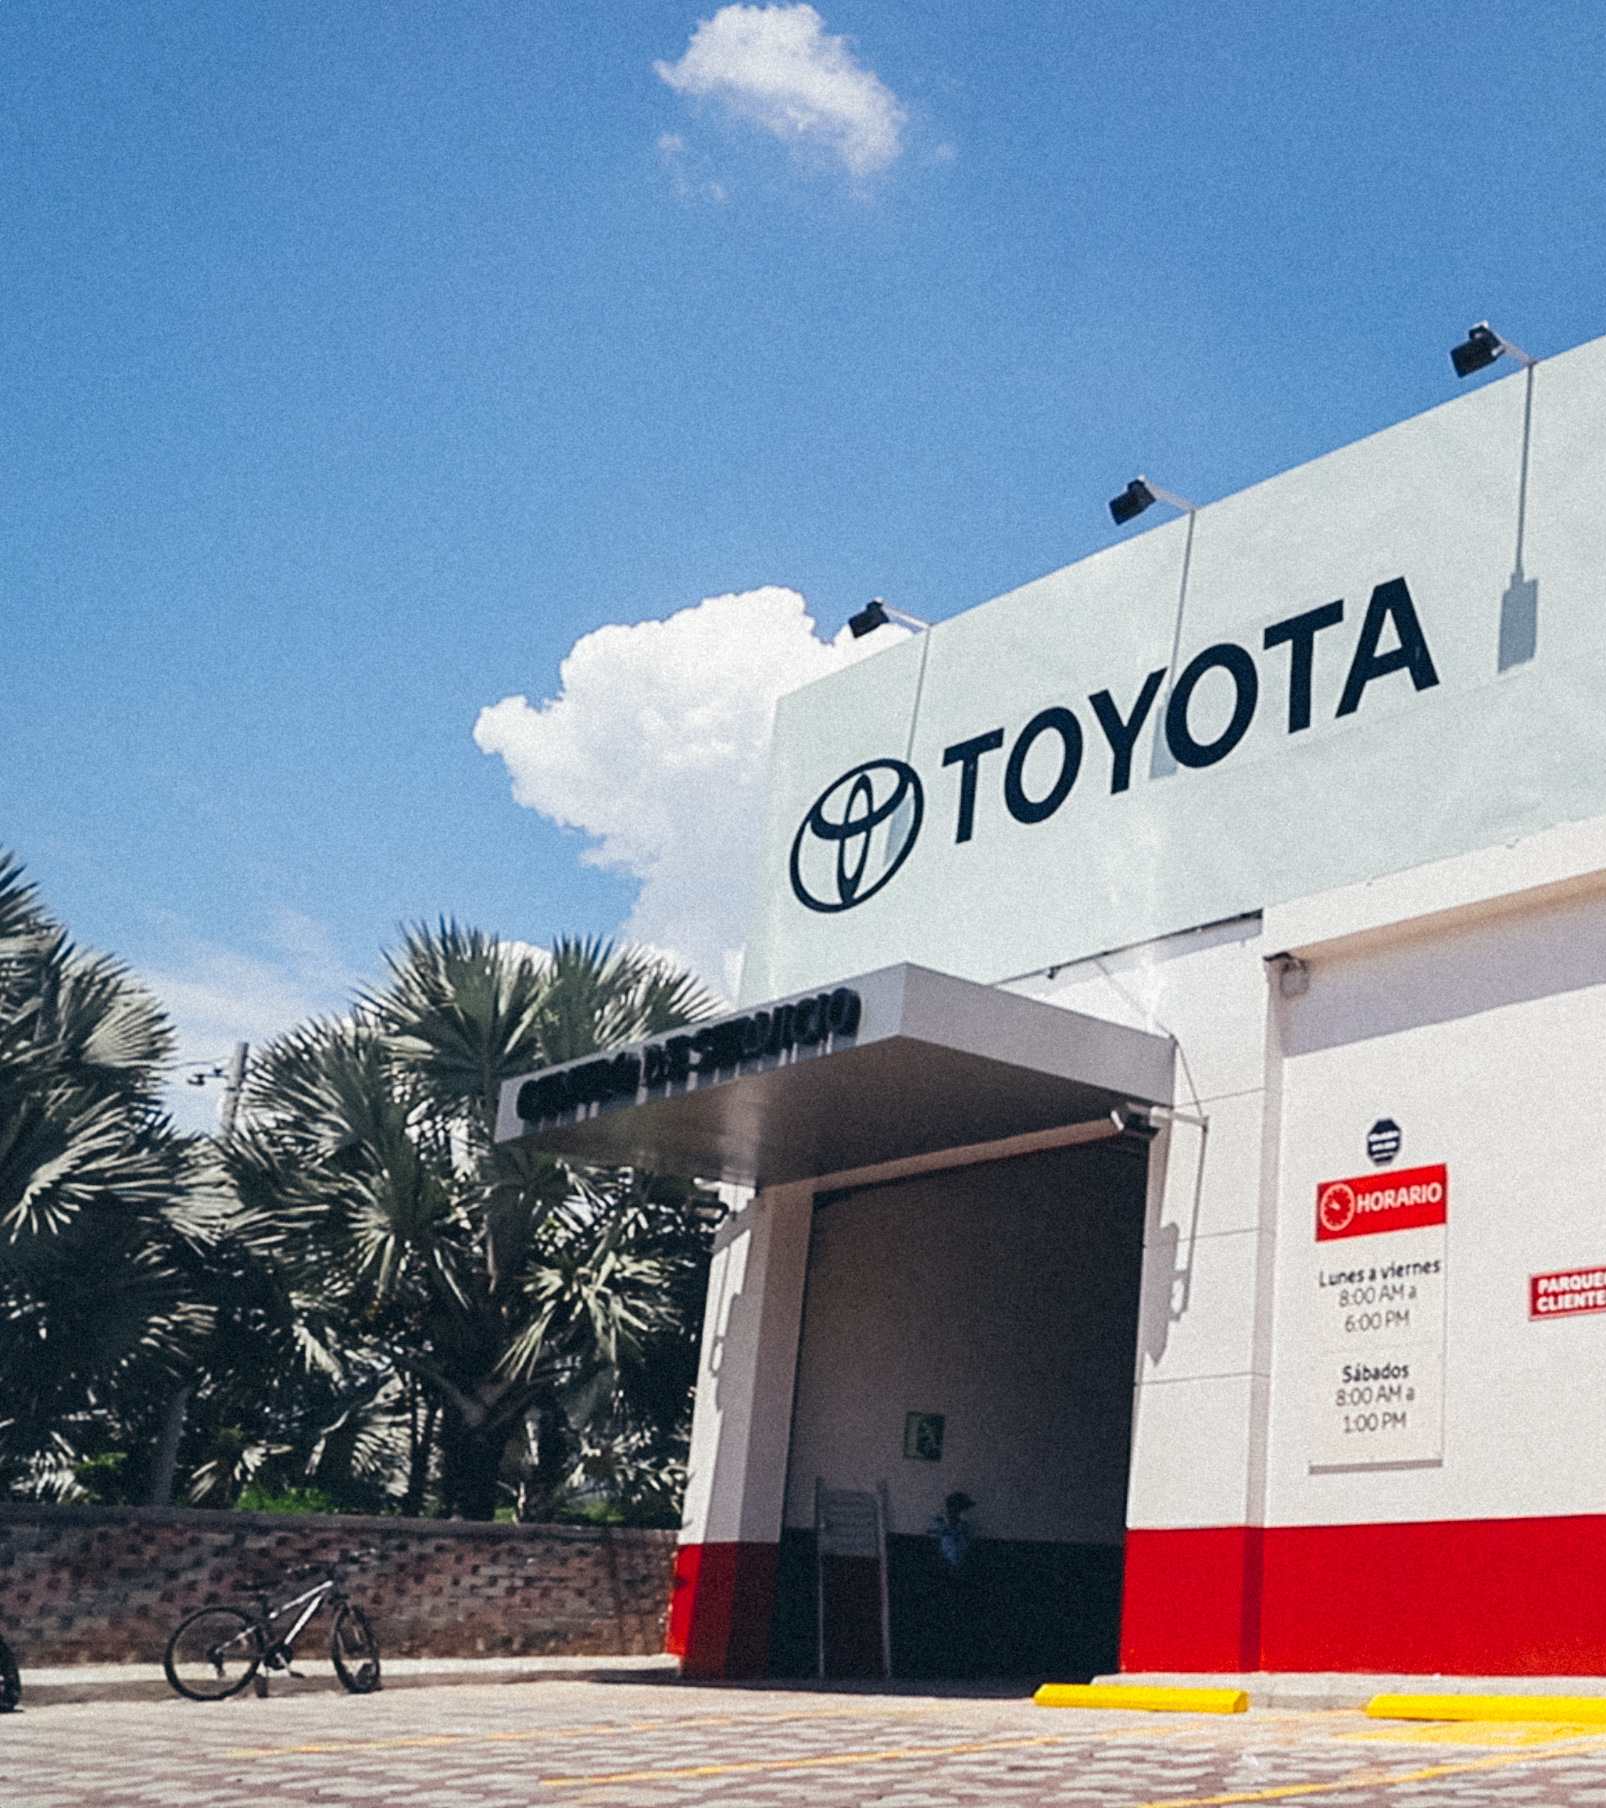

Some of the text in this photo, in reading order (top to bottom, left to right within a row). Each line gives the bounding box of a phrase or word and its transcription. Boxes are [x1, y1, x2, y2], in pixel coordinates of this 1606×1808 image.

[942, 576, 1439, 843] TOYOTA
[1356, 1182, 1443, 1213] HORARIO
[1319, 1260, 1440, 1287] Lunes a viernes
[1339, 1283, 1417, 1307] 8:00 AM a
[1345, 1309, 1410, 1333] 6:00 PM
[1342, 1361, 1409, 1383] Sábados
[1336, 1384, 1415, 1407] 8:00 AM a
[1343, 1411, 1407, 1433] 1:00 PM
